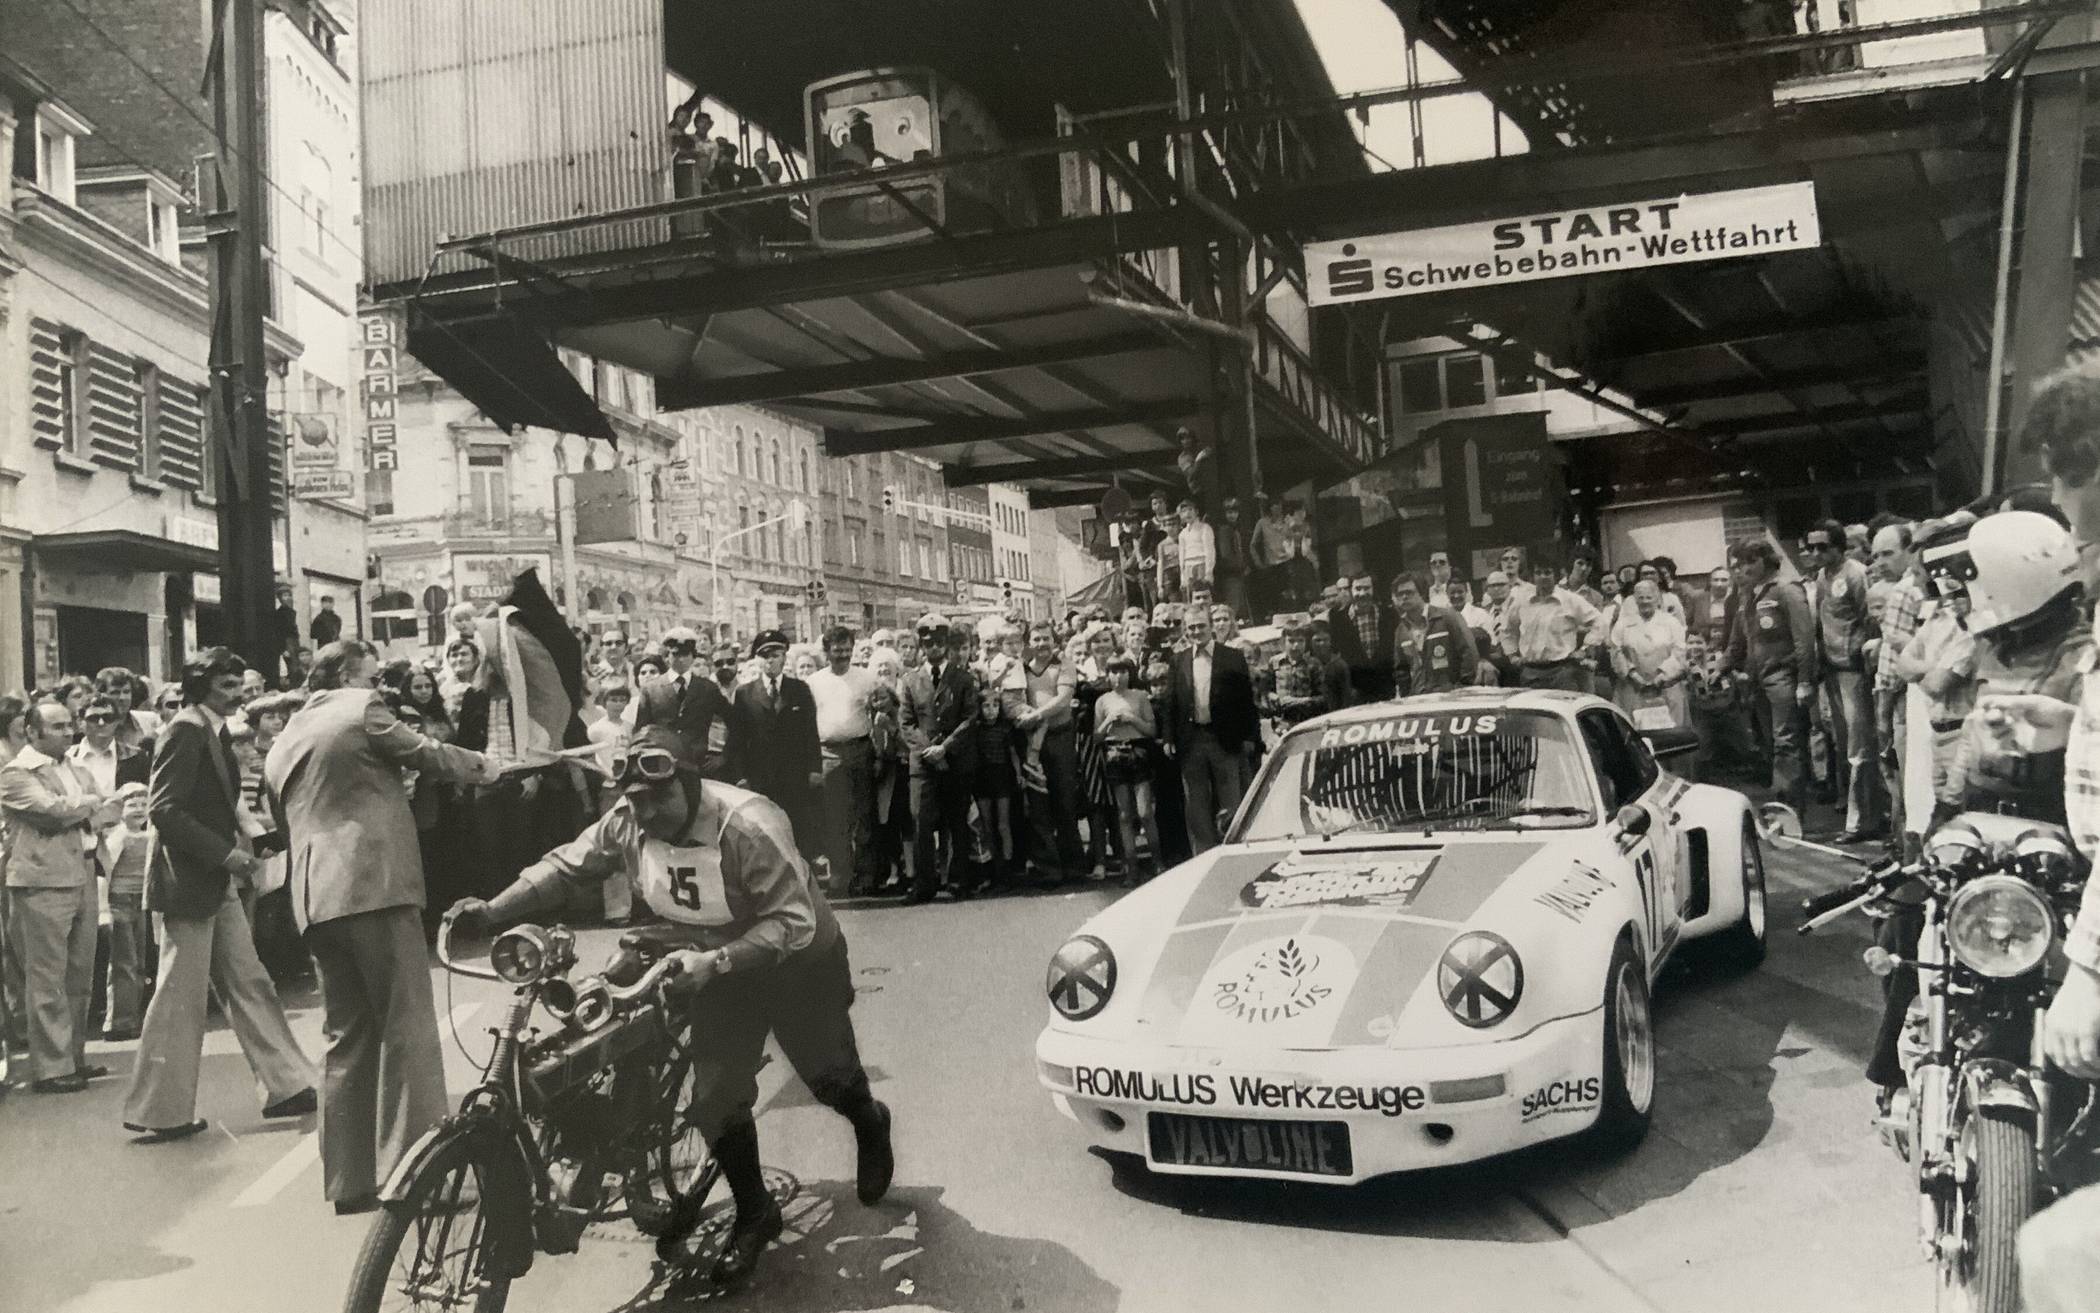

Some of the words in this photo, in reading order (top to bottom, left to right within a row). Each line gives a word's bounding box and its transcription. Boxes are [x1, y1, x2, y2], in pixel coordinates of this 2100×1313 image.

[1492, 202, 1680, 251] START
[1383, 219, 1799, 290] Schwebebahn-Wettfahrt
[366, 323, 396, 471] BARMER
[1320, 715, 1497, 749] ROMULUS
[666, 865, 702, 911] 15
[1213, 981, 1333, 1024] ROMULUS
[1075, 1066, 1217, 1106] ROMULUS
[1229, 1075, 1425, 1117] Werkzeuge
[1521, 1077, 1600, 1117] SACHS
[1164, 1114, 1337, 1174] VALVOLINE
